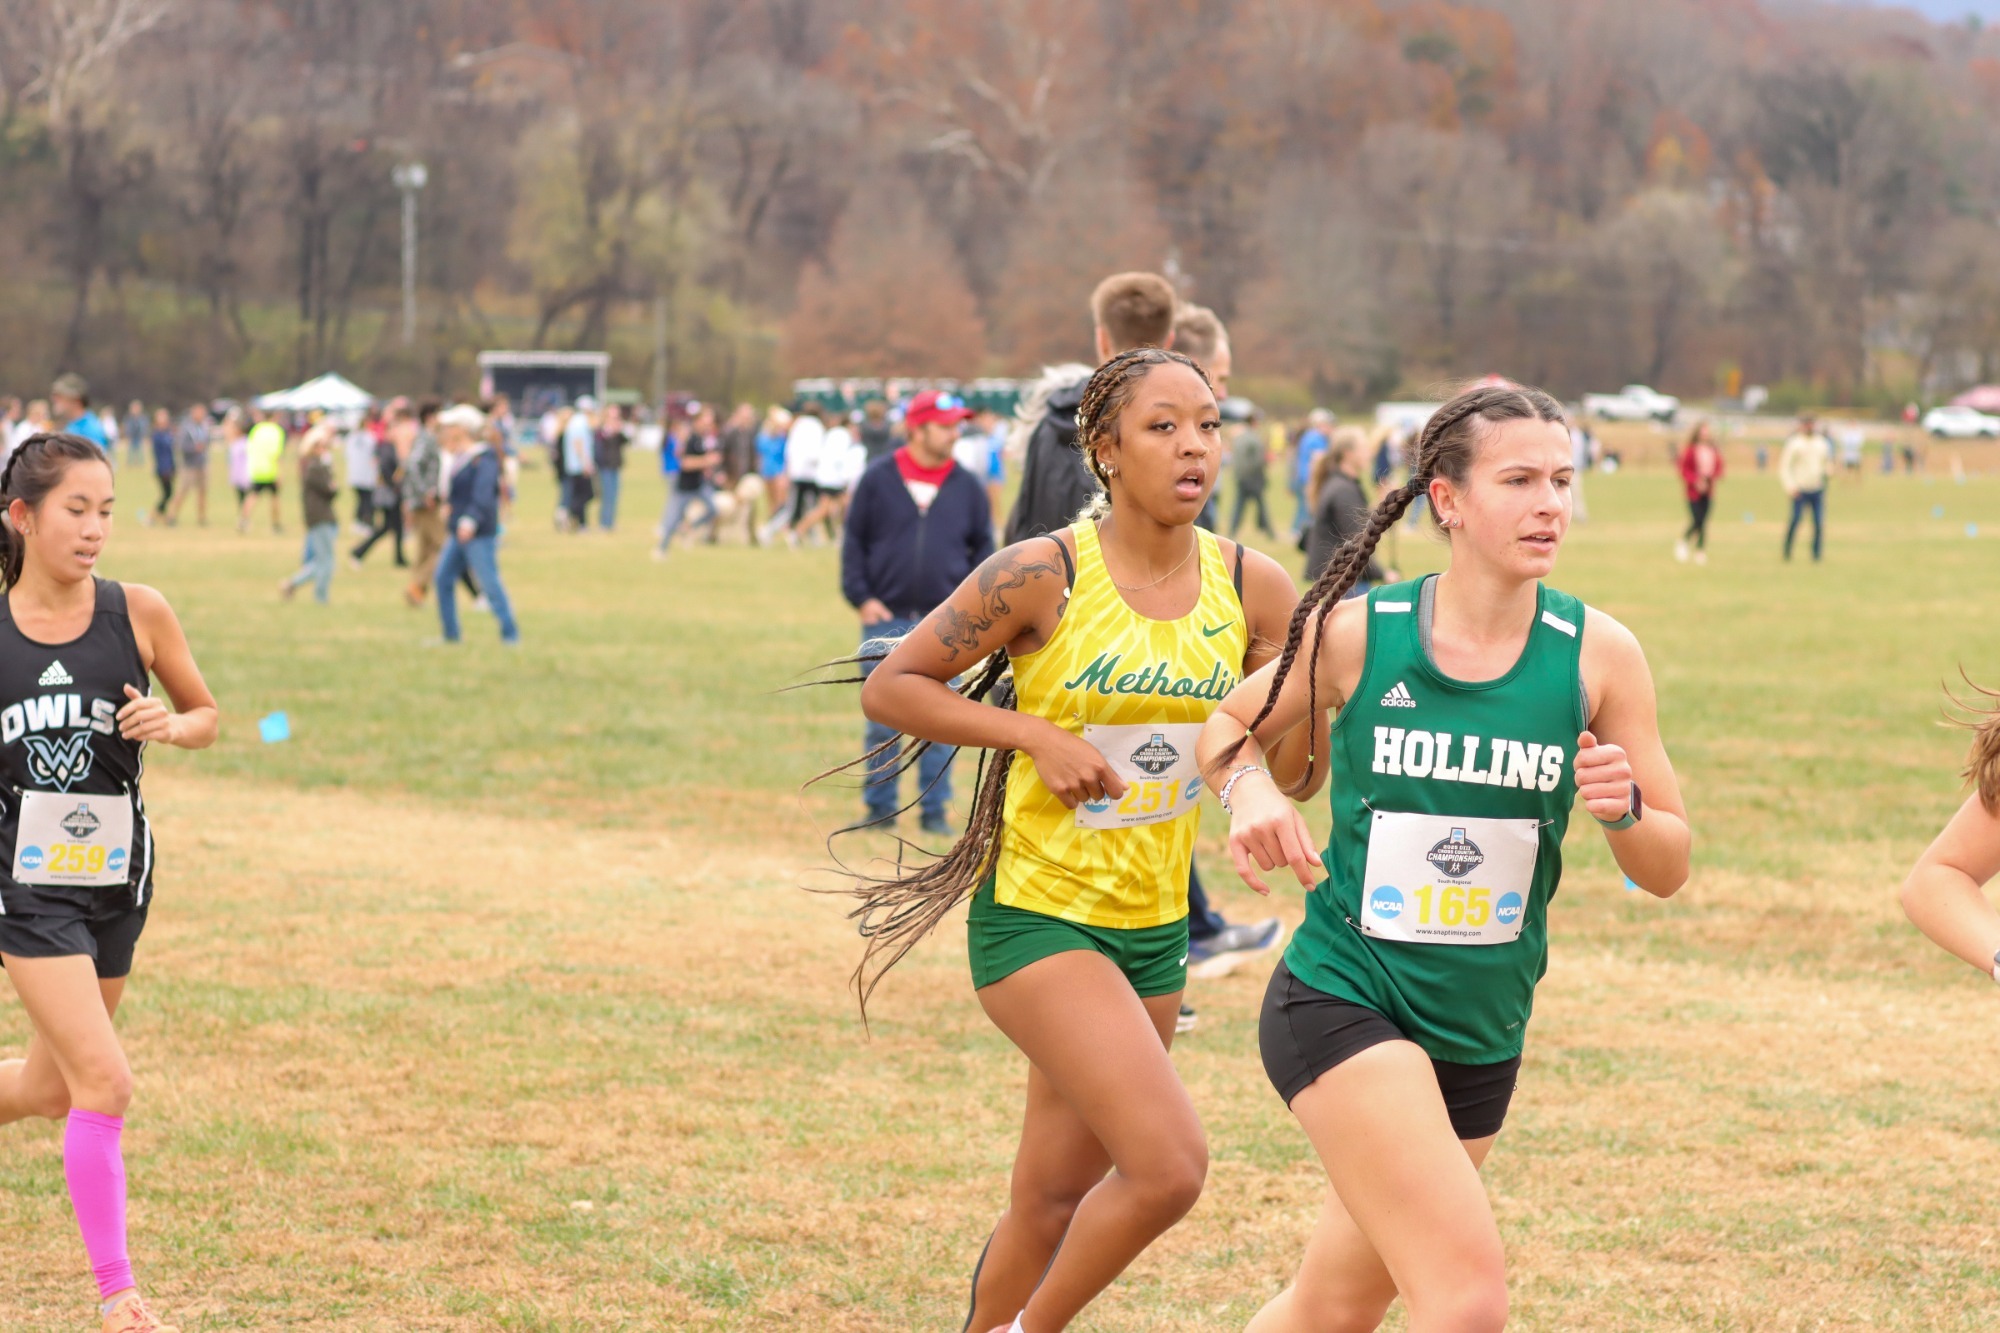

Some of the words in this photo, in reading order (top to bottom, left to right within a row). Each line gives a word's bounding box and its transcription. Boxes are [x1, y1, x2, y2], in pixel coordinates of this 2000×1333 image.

[38, 675, 74, 686] adidas
[1380, 697, 1416, 708] adidas
[1, 694, 116, 744] OWLS
[1372, 726, 1565, 792] HOLLINS
[1117, 778, 1181, 814] 251
[20, 856, 42, 865] NCAA
[47, 843, 106, 873] 259
[108, 857, 125, 866] NCAA
[1428, 852, 1484, 864] CHAMPIONSHIPS
[1373, 900, 1403, 912] NCAA
[1413, 884, 1490, 927] 165
[1497, 906, 1520, 917] NCAA
[1415, 928, 1482, 937] www.snaptiming.com
